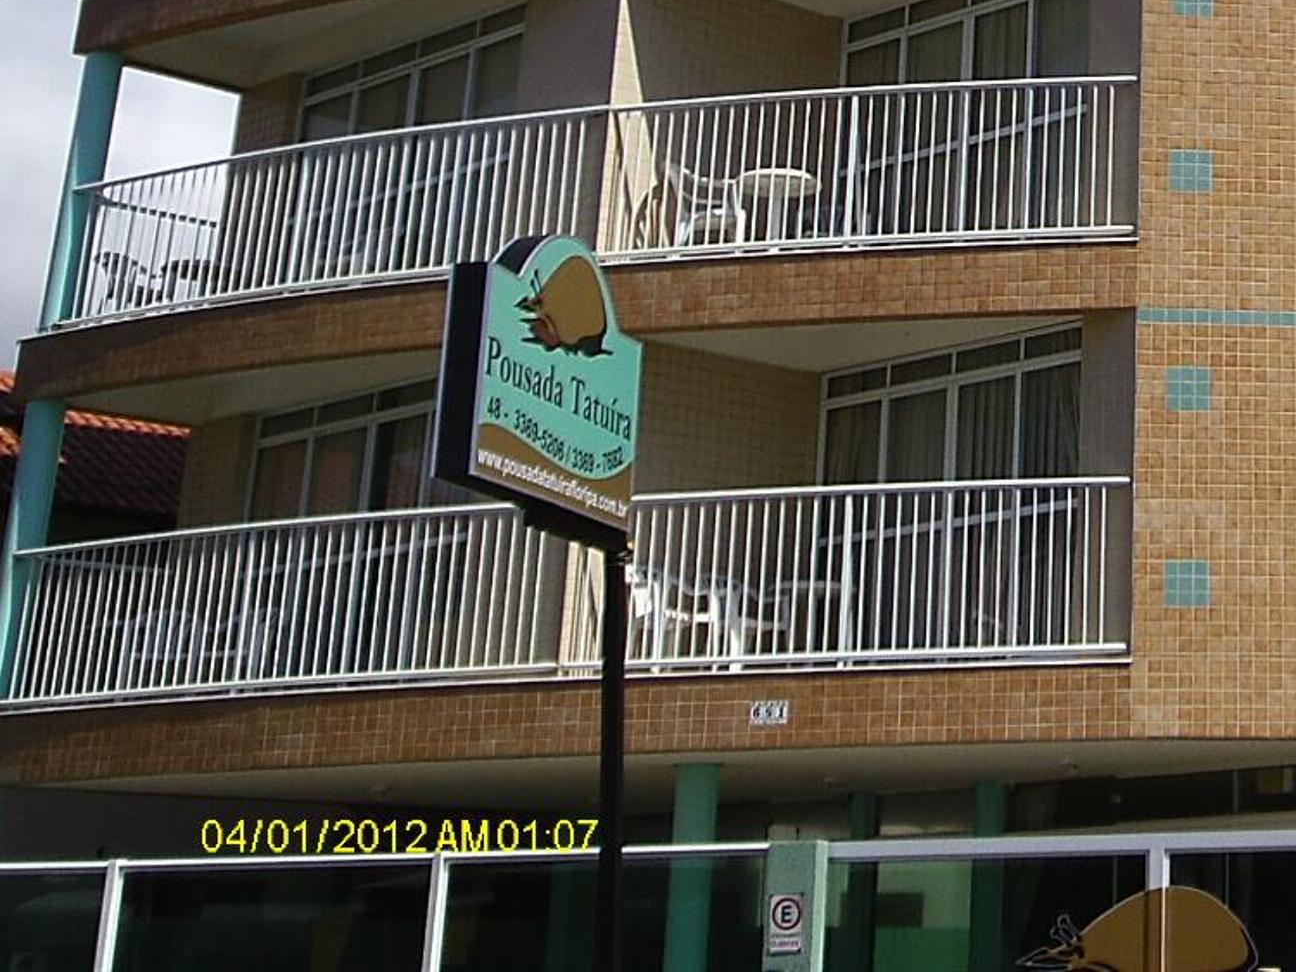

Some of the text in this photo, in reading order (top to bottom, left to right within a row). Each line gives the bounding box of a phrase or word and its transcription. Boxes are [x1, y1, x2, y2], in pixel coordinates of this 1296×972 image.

[485, 336, 632, 441] Pousada Tatuíra
[487, 396, 501, 419] 48
[780, 904, 793, 924] E
